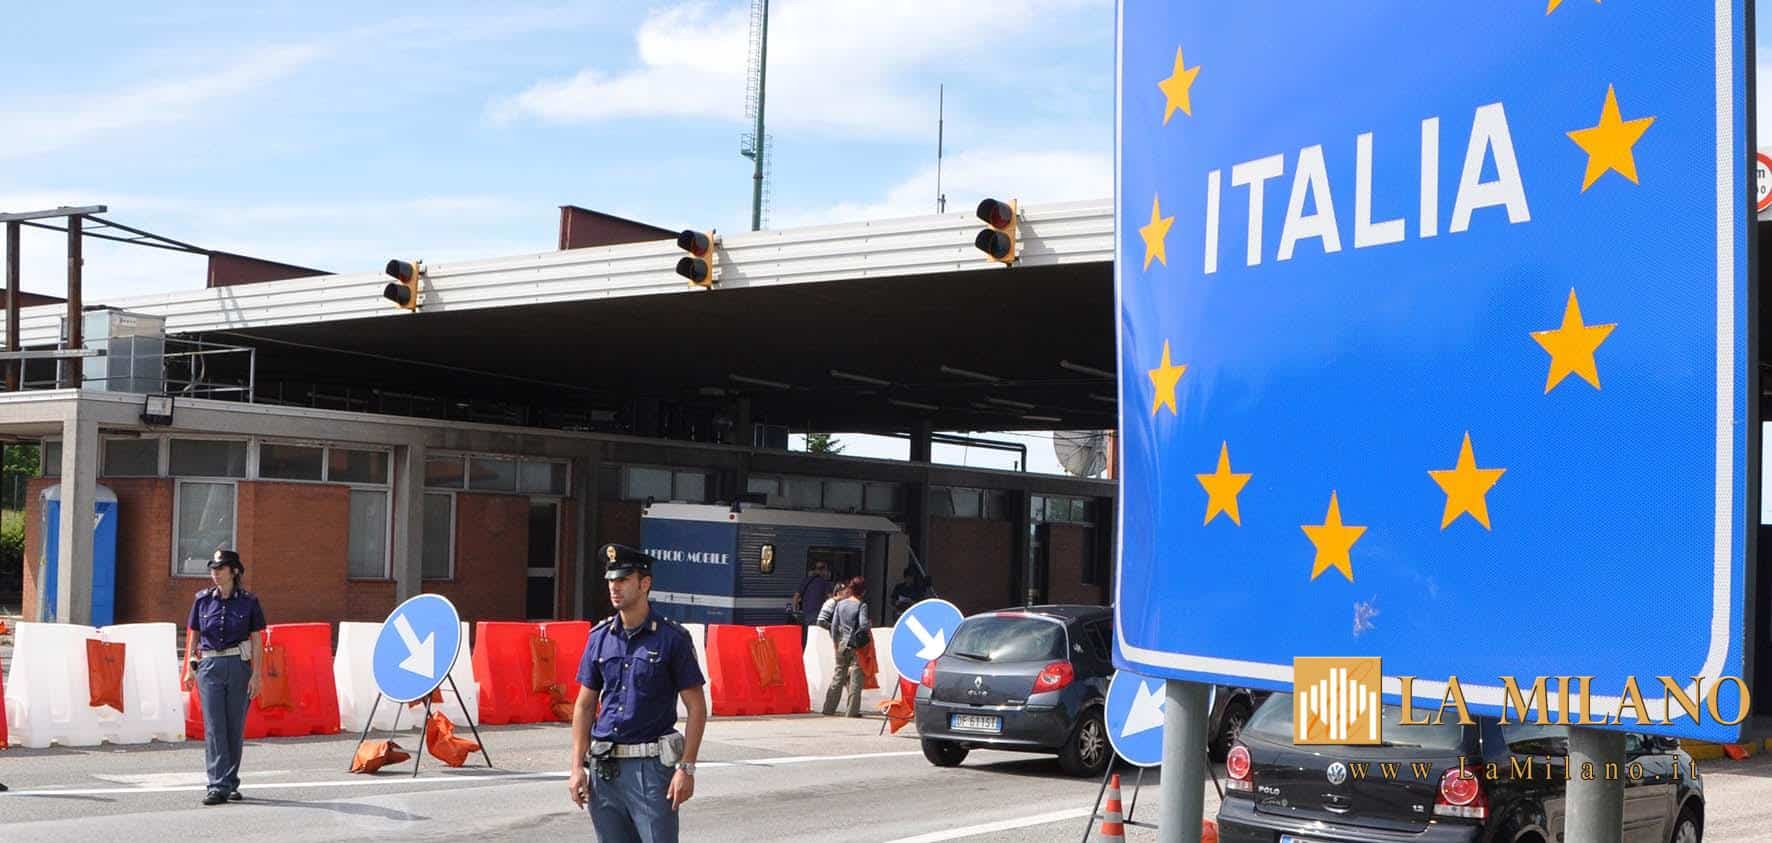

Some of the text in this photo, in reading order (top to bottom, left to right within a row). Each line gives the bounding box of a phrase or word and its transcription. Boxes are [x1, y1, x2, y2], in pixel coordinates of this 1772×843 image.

[1203, 101, 1531, 275] ITALIA
[687, 551, 729, 565] MOBILE
[1257, 785, 1281, 796] POLO
